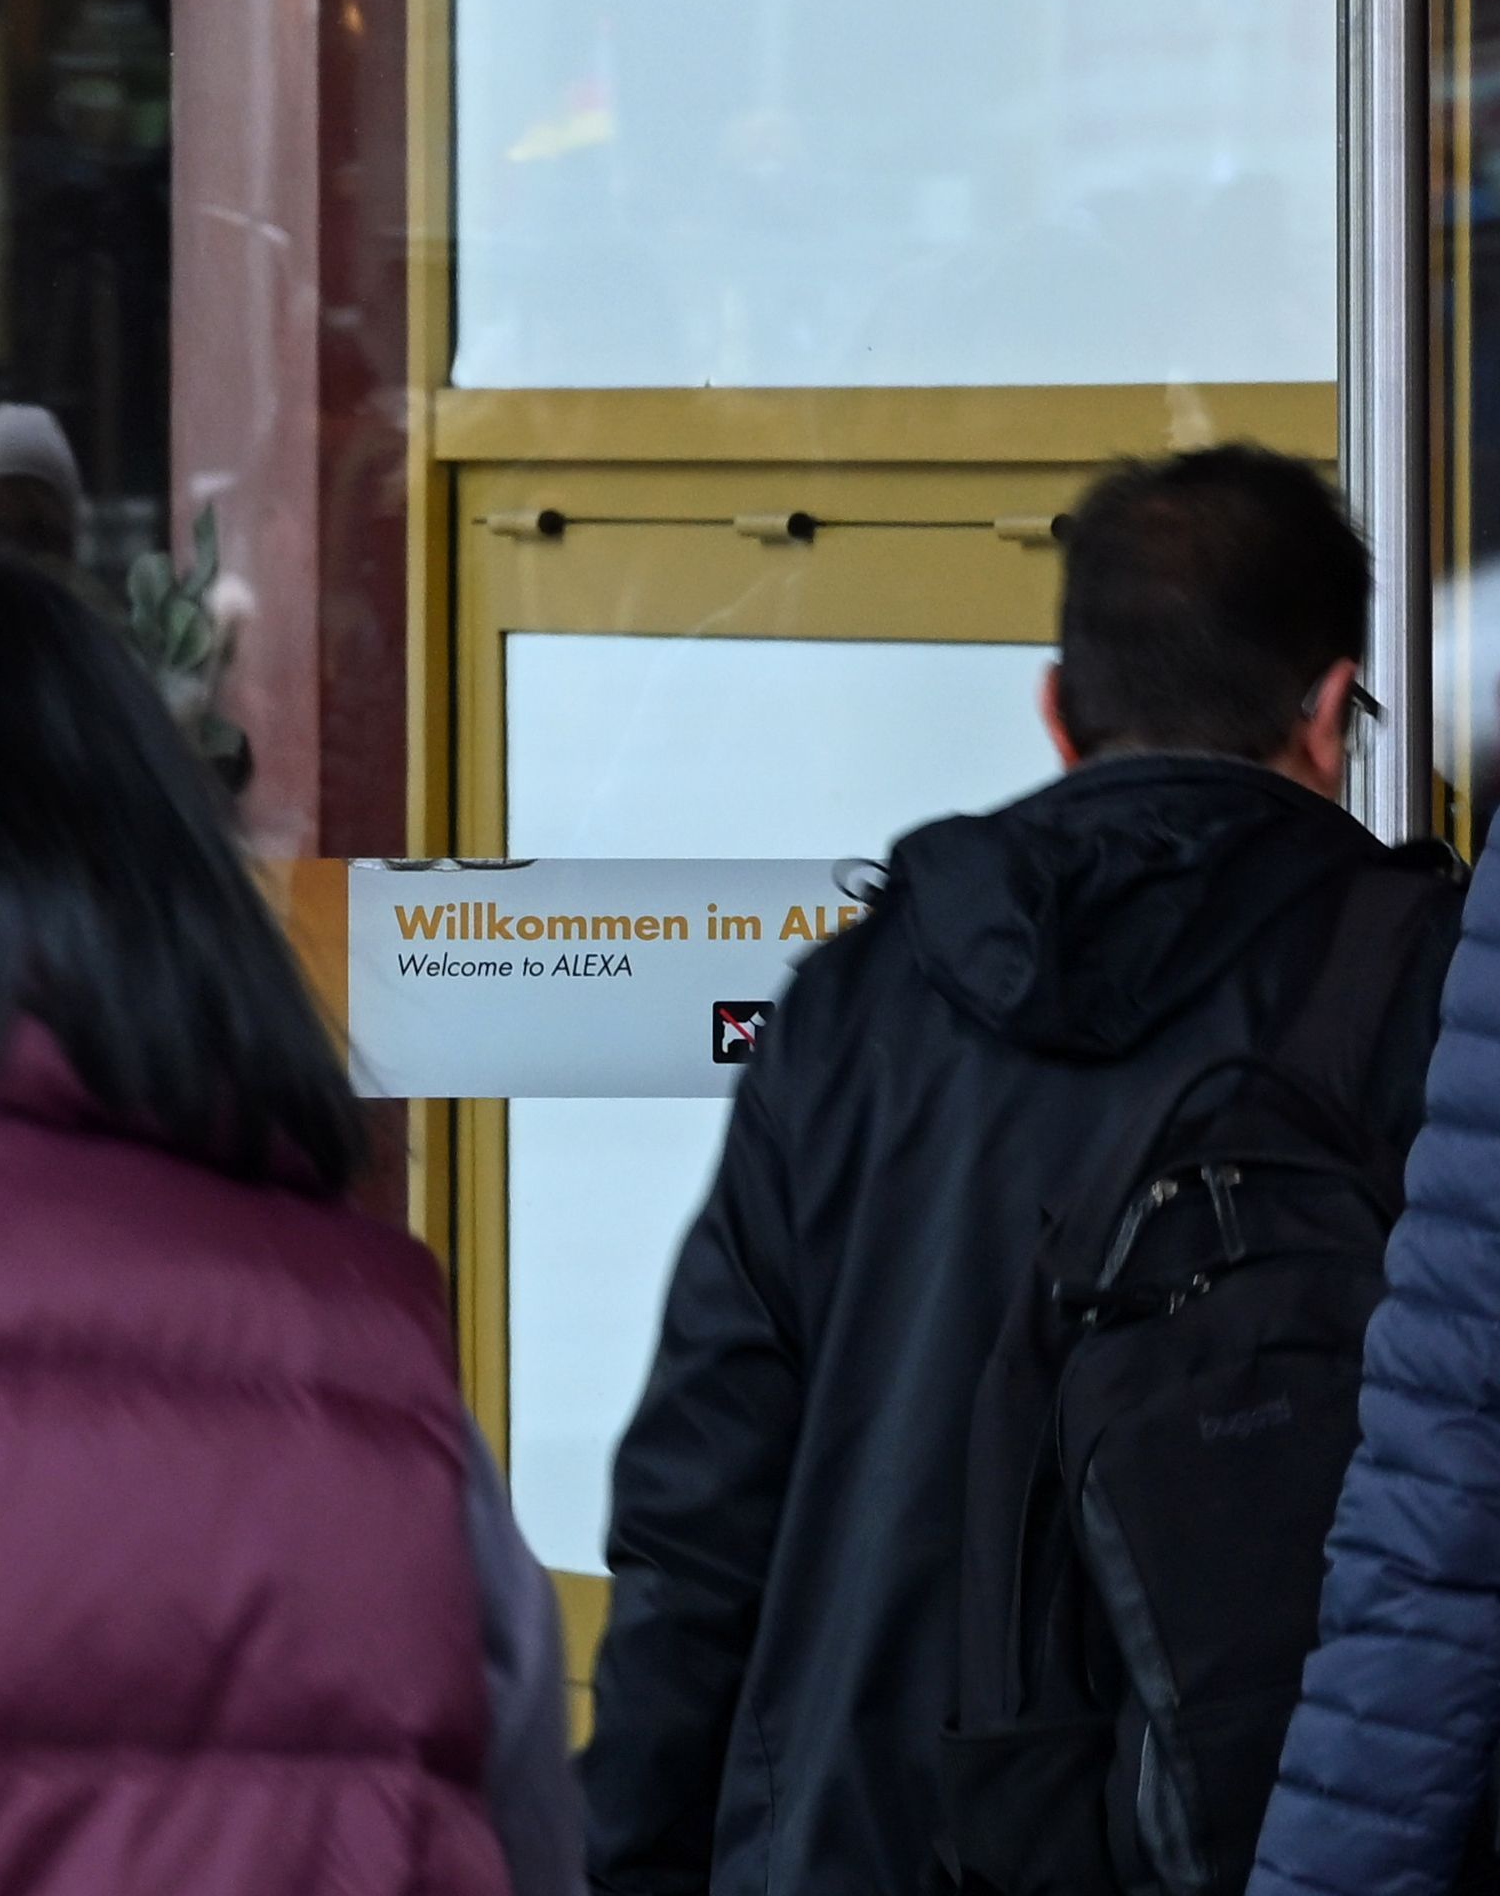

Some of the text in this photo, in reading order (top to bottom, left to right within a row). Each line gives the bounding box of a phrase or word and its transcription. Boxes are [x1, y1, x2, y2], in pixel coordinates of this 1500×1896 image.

[395, 903, 862, 941] Willkommen im ALE
[398, 954, 633, 978] Welcome to ALEXA
